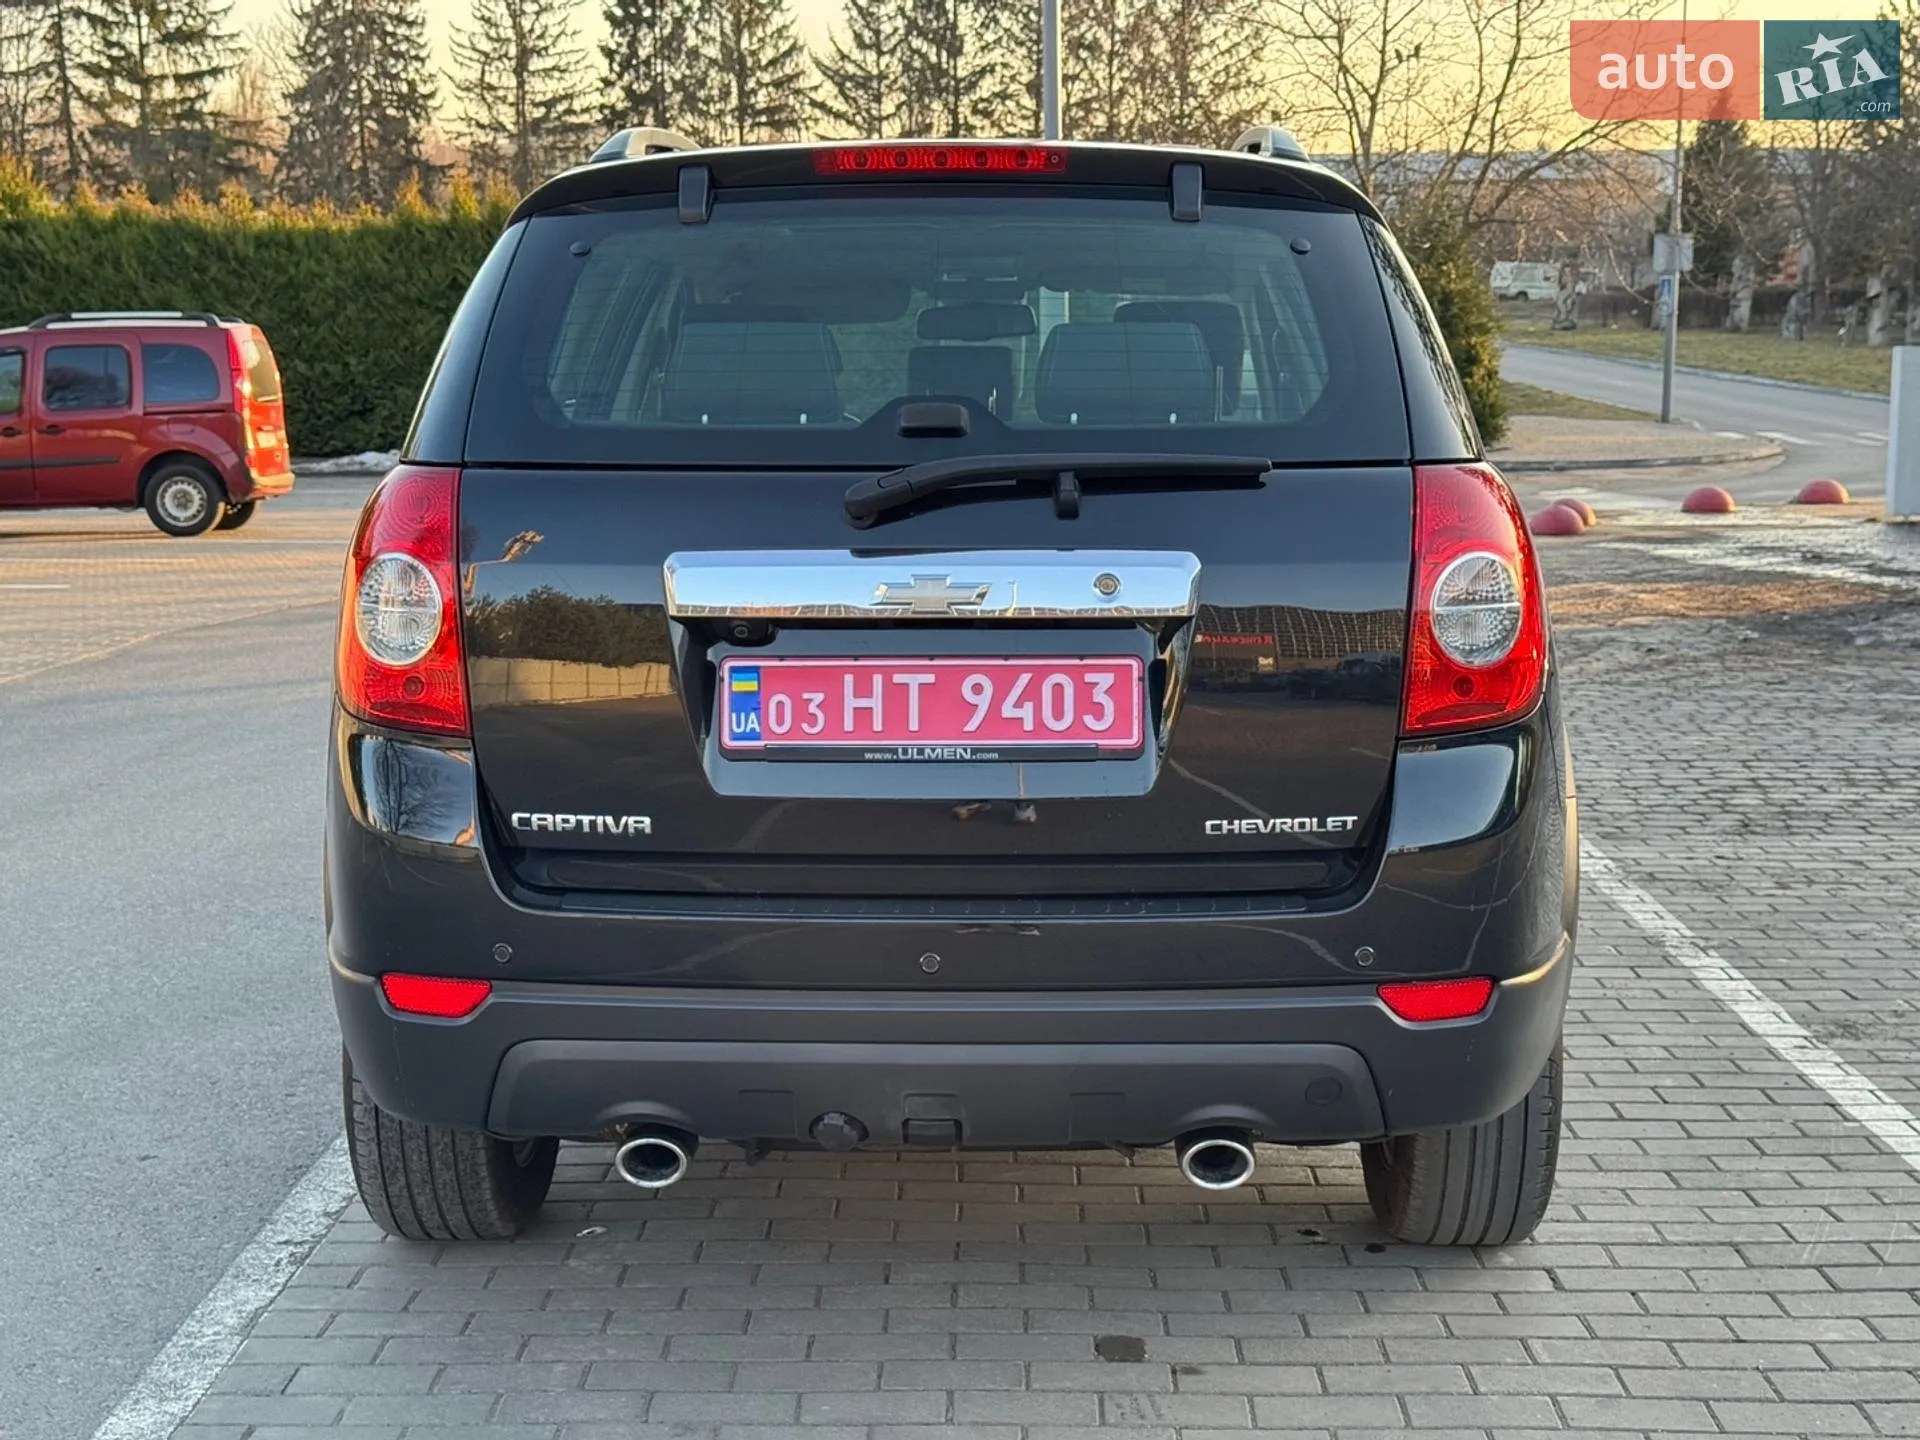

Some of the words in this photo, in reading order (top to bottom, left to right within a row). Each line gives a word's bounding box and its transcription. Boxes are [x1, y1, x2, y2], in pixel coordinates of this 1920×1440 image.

[767, 692, 826, 735] 03
[843, 673, 936, 733] HT
[960, 672, 1116, 733] 9403
[731, 712, 760, 733] UA
[864, 747, 999, 760] www.ULMEN.com
[511, 812, 652, 836] CAPTIVA
[1204, 816, 1358, 835] CHEVROLET
